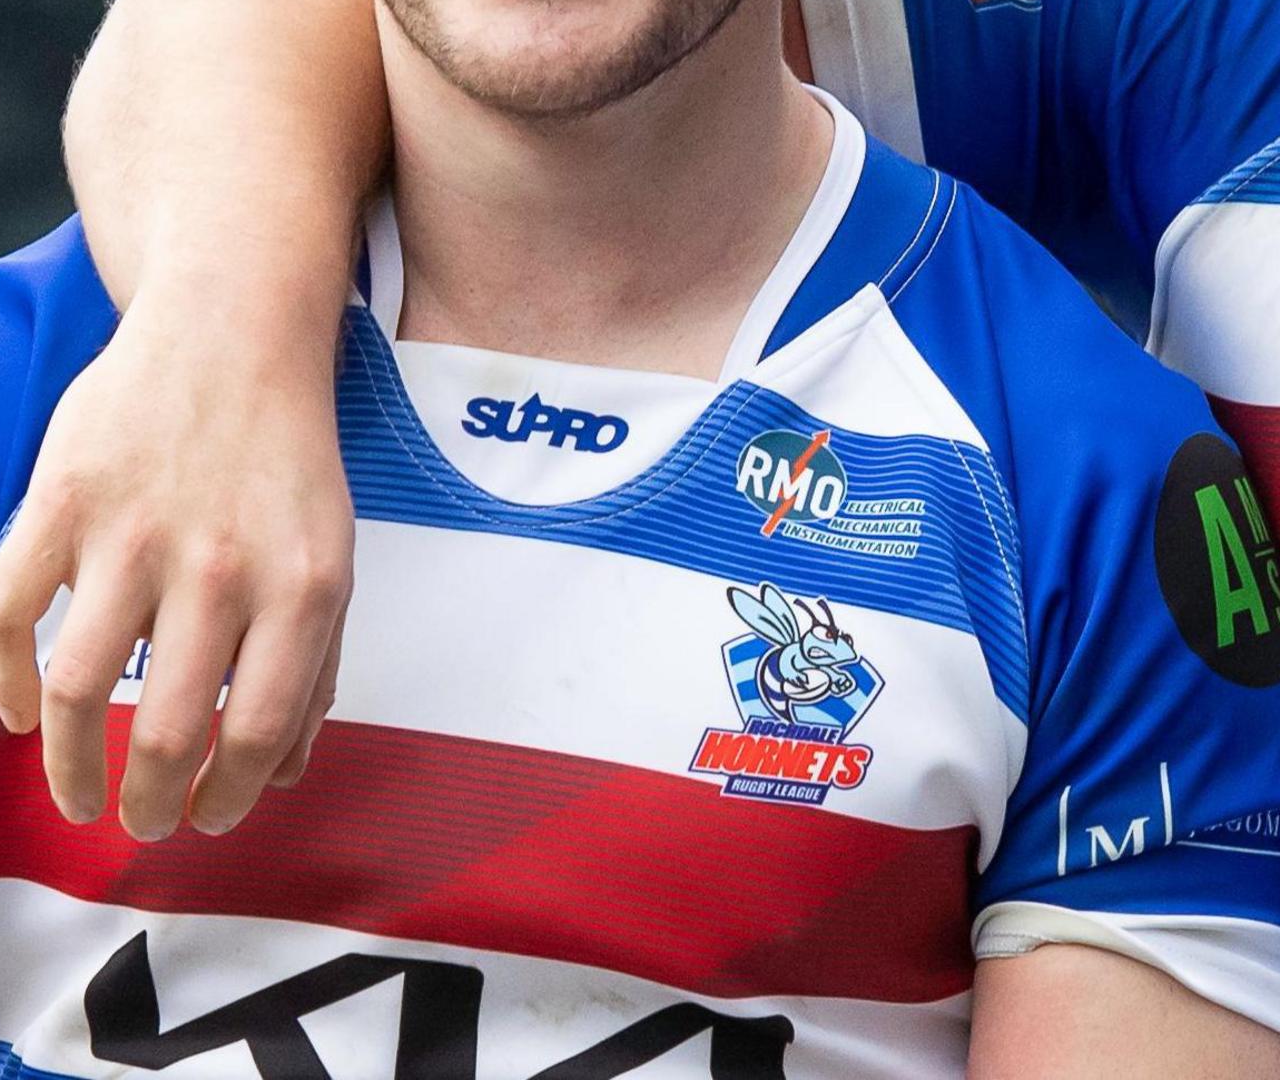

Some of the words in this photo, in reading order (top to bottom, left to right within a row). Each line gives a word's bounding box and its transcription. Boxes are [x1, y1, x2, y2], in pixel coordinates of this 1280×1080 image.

[461, 392, 629, 453] SUPRO
[736, 446, 844, 519] RMO
[846, 500, 925, 515] ELECTRICAL
[784, 523, 918, 557] INSTRUMENTATION
[830, 519, 921, 535] MECHANICAL
[749, 719, 840, 744] ROCHDALE
[696, 731, 869, 785] HORNETS
[732, 778, 774, 795] RUGBY
[775, 784, 822, 801] LEAGUE
